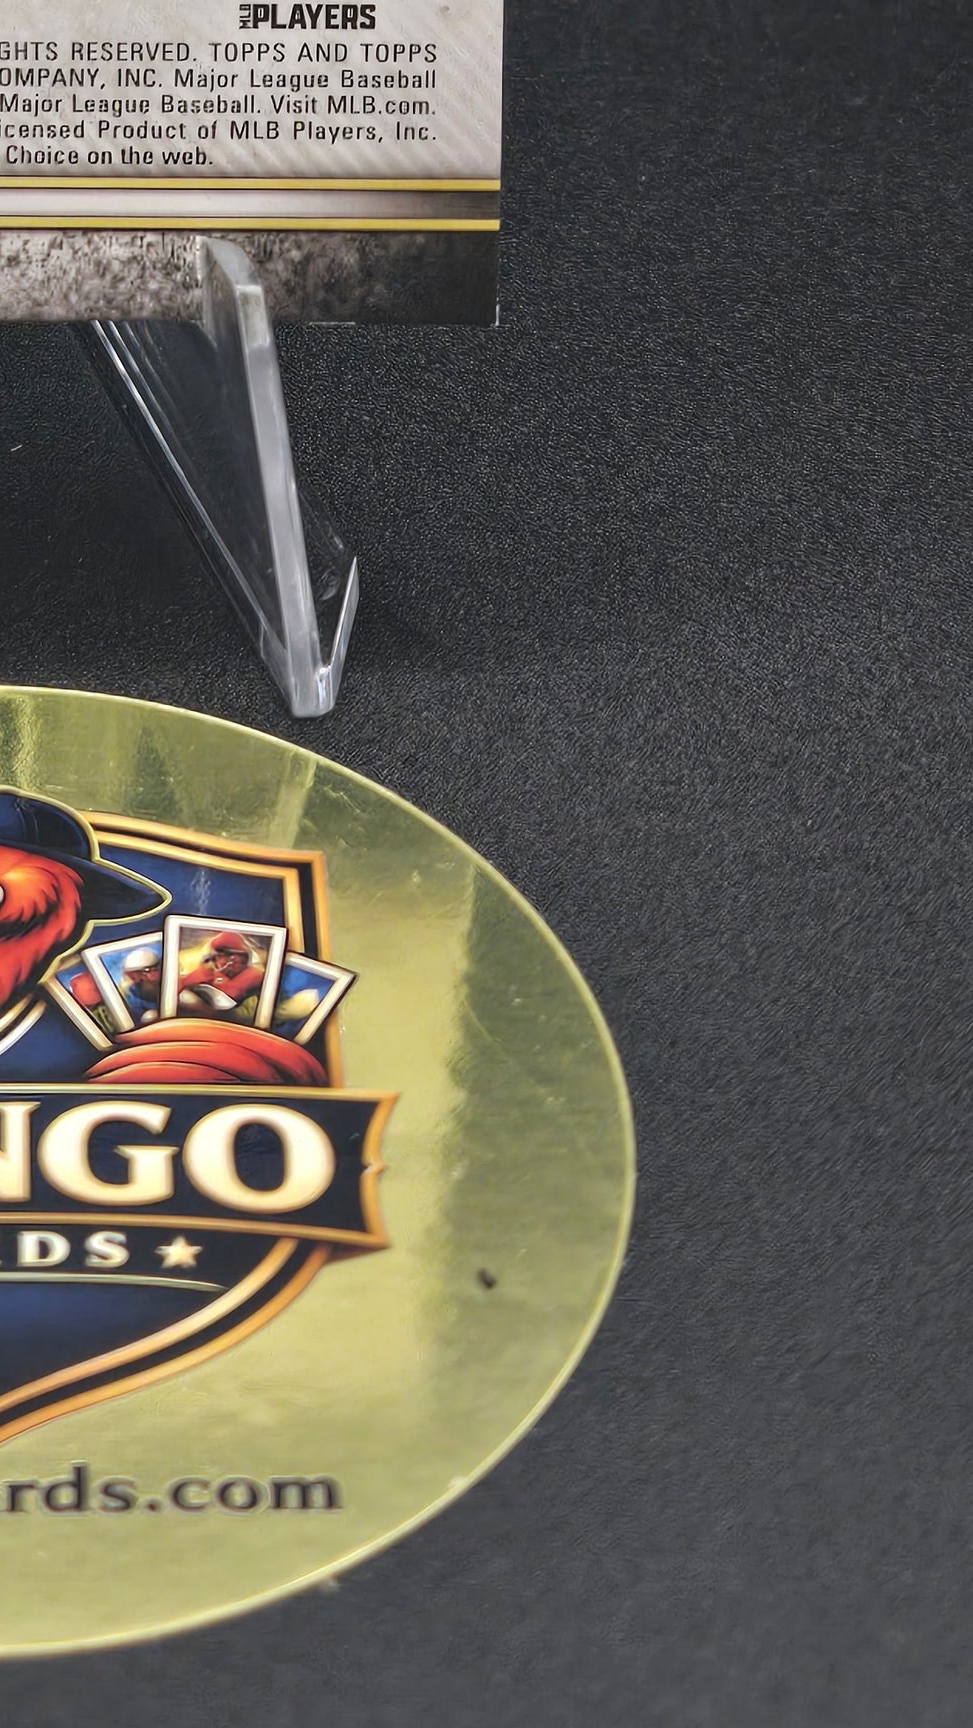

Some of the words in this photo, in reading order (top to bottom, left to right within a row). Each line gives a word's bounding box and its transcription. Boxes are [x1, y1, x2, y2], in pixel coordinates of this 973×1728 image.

[253, 3, 376, 30] PLAYERS
[72, 42, 196, 62] RESERVED.
[209, 43, 285, 62] TOPPS
[298, 43, 347, 62] AND
[360, 44, 436, 63] TOPPS
[118, 69, 162, 87] INC.
[175, 69, 238, 90] Major
[251, 70, 328, 91] League
[342, 70, 435, 88] Baseball
[0, 94, 62, 117] Major
[73, 94, 149, 117] League
[162, 95, 261, 114] Baseball.
[271, 95, 317, 115] Visit
[328, 95, 436, 115] MLB.com.
[6, 145, 78, 164] Choice
[88, 151, 112, 164] on
[121, 146, 153, 164] the
[162, 146, 214, 165] web.
